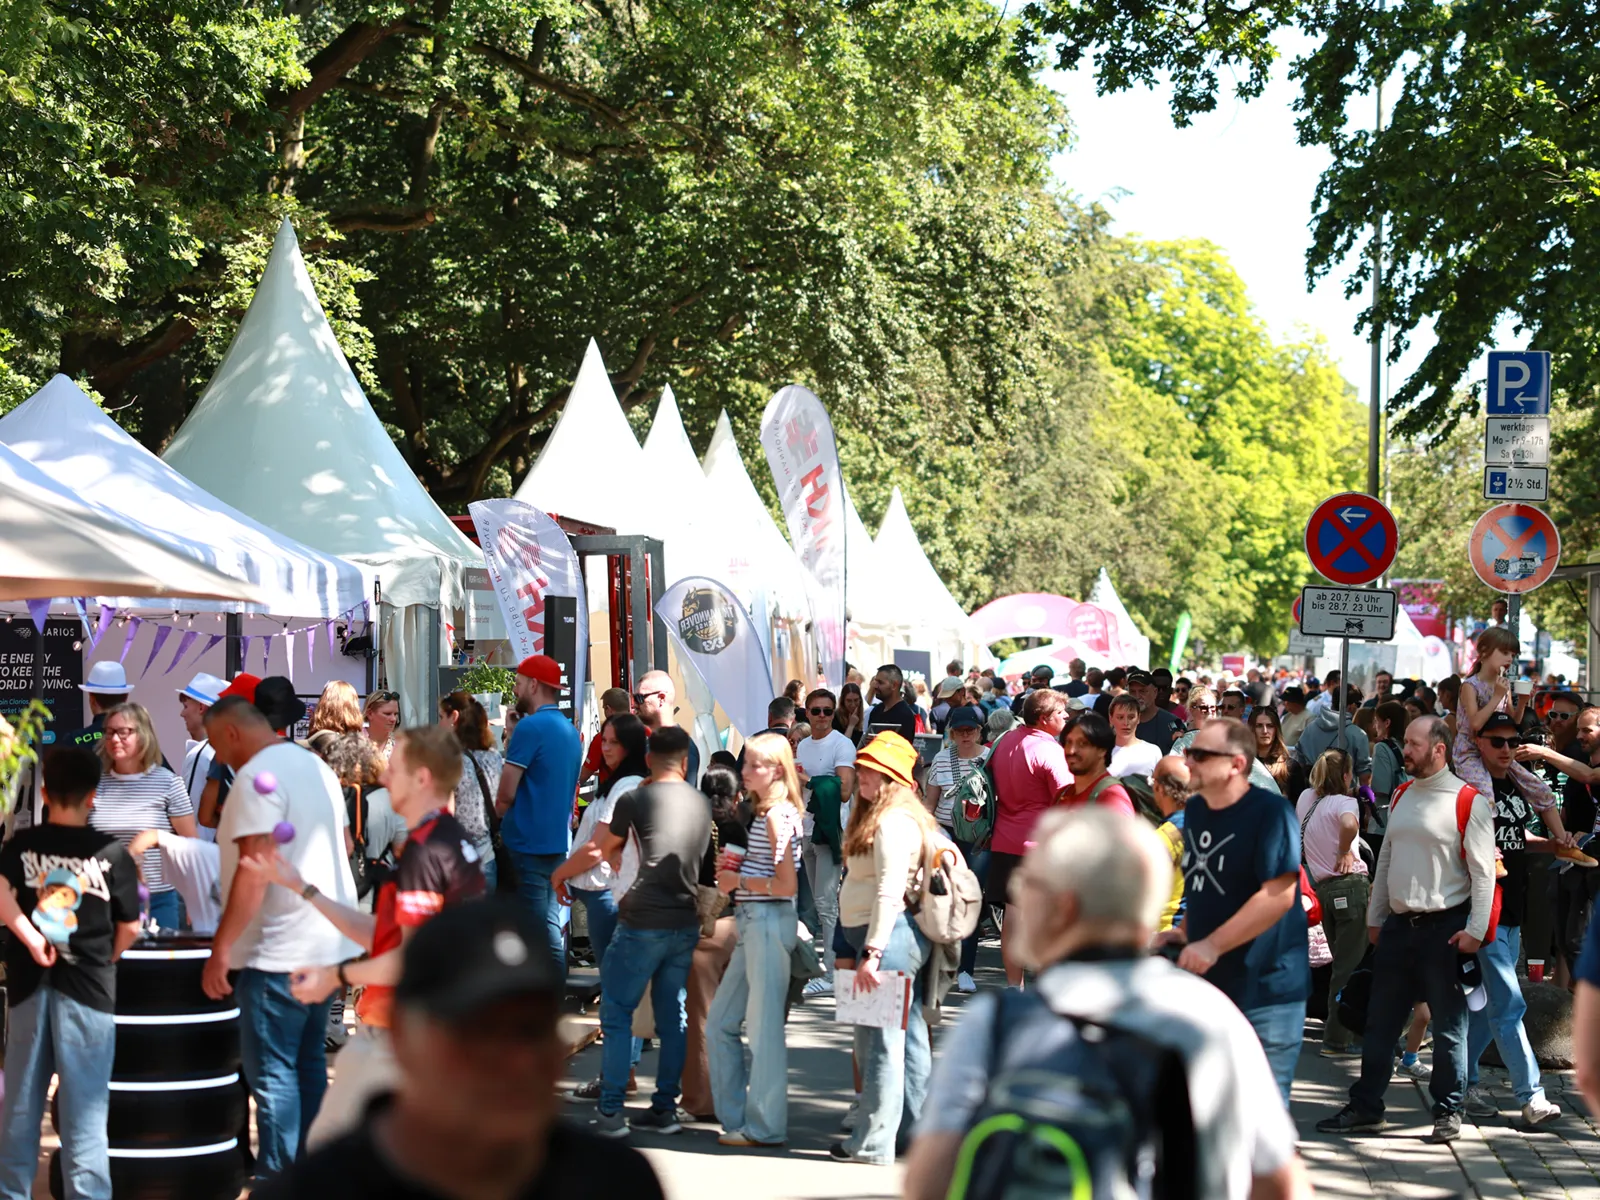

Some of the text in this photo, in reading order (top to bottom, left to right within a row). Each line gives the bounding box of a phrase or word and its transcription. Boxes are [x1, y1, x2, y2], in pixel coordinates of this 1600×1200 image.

[1500, 423, 1534, 434] werktags
[1492, 436, 1503, 445] Mo
[1511, 436, 1519, 445] Fr
[1500, 450, 1510, 459] Sa
[1507, 478, 1513, 489] 2
[1526, 479, 1543, 490] Std.
[1316, 593, 1380, 603] ab 20.7. 6 Uhr
[1311, 601, 1383, 613] bis 28.7. 23 Uhr
[43, 628, 75, 637] ARIOS
[9, 653, 52, 664] ENEY
[12, 666, 34, 677] KEE
[0, 679, 27, 690] ORLD
